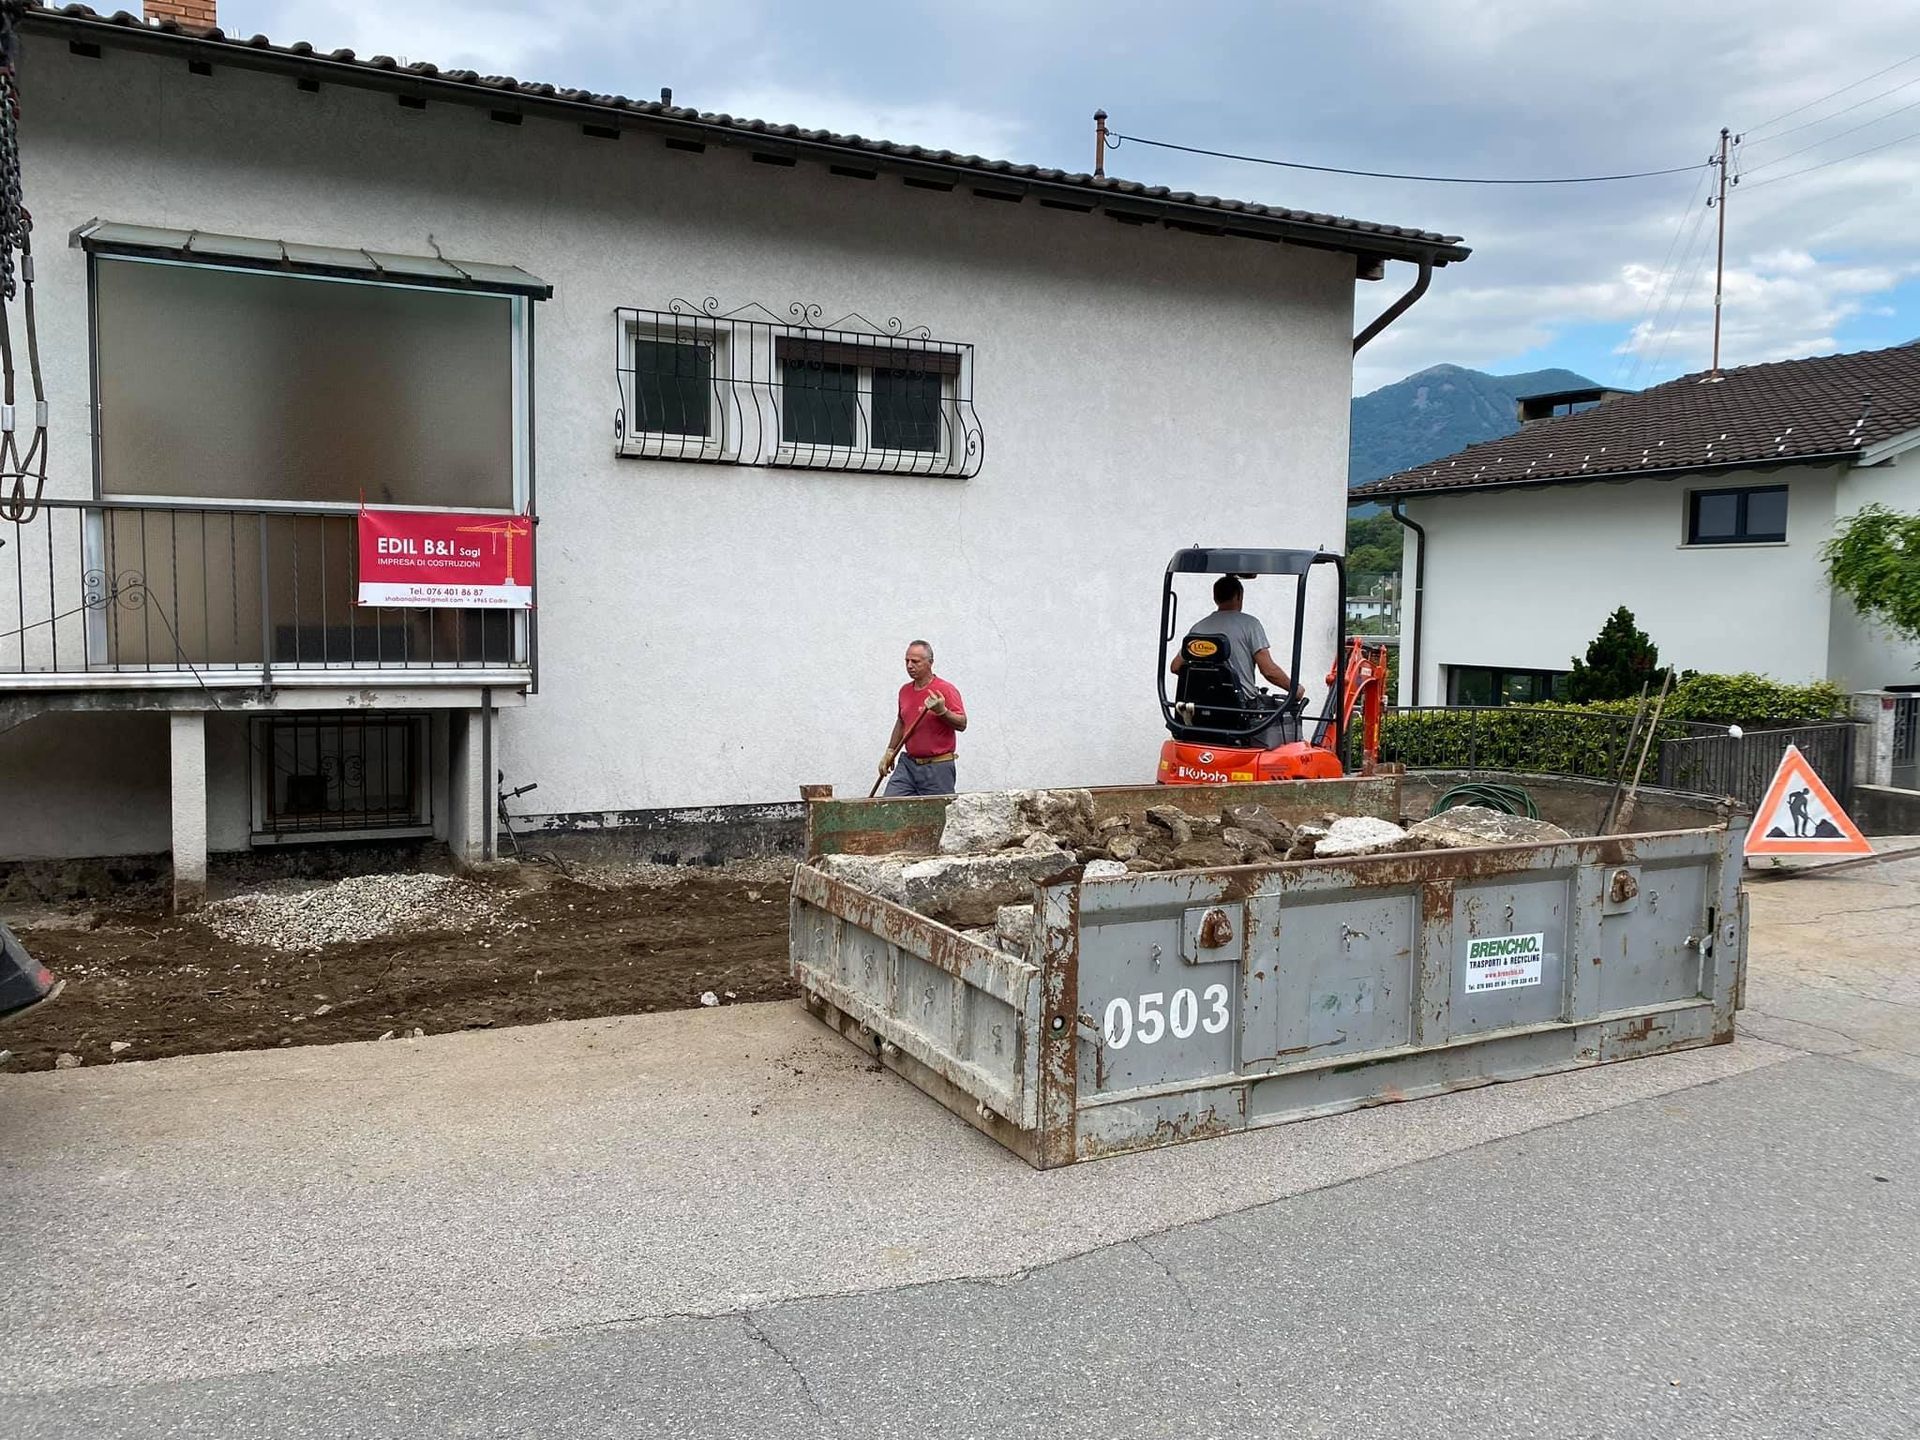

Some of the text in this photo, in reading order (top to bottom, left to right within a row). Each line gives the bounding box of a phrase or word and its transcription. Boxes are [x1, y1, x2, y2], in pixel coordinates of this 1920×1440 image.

[377, 537, 481, 558] EDIL B&I Sagl
[377, 558, 481, 568] IMPRESA DI COSTRUZIONI
[410, 587, 484, 597] Tel. 076 401 86 87
[1184, 766, 1229, 783] Kubota
[1469, 936, 1536, 958] BRENCHIO
[1469, 953, 1540, 969] TRASPORTI & RECYCLING
[1103, 983, 1231, 1050] 0503
